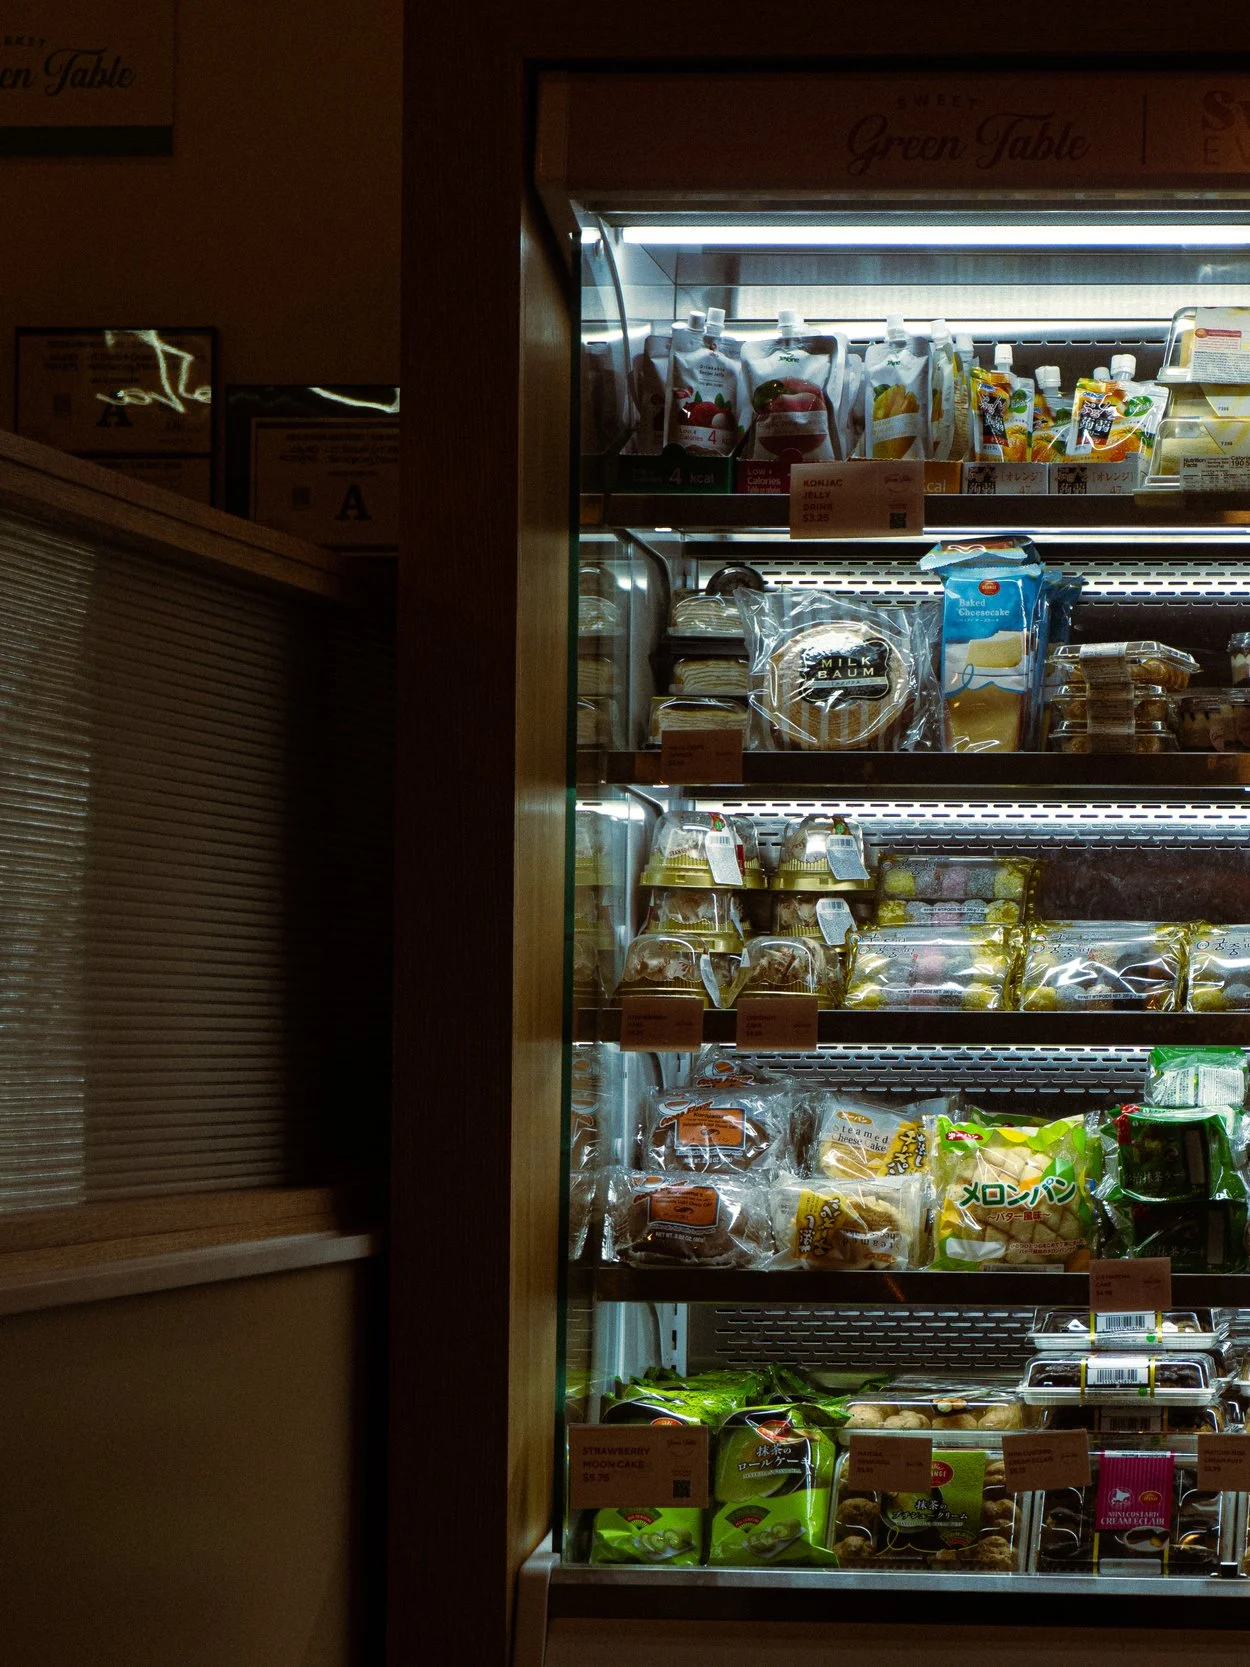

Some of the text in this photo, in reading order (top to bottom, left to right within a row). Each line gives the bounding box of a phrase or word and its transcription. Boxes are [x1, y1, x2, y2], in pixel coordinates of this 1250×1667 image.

[45, 46, 137, 96] Table
[898, 94, 977, 110] SWEET
[846, 111, 1091, 176] Green Table
[707, 430, 716, 444] 4
[668, 467, 683, 485] 4
[688, 470, 715, 484] kcal
[746, 476, 782, 487] Calories
[802, 478, 843, 488] KONJAC
[802, 490, 831, 499] JELLY
[335, 484, 371, 520] A
[802, 503, 833, 511] DRINK
[958, 598, 986, 607] Baked
[958, 608, 1010, 617] Cheesecake
[821, 656, 871, 668] MILK
[818, 667, 875, 679] BAUM
[832, 1123, 889, 1144] Steamed
[831, 1132, 887, 1152] Cheese Cake
[957, 1176, 1077, 1209] メロンパン
[582, 1446, 650, 1456] STRAWBERRY
[757, 1443, 792, 1457] 抹茶の
[583, 1460, 645, 1469] MOON CAKE
[582, 1473, 610, 1482] $5.75
[916, 1498, 948, 1510] 抹茶の
[1100, 1516, 1165, 1525] CREAM ECLAIR
